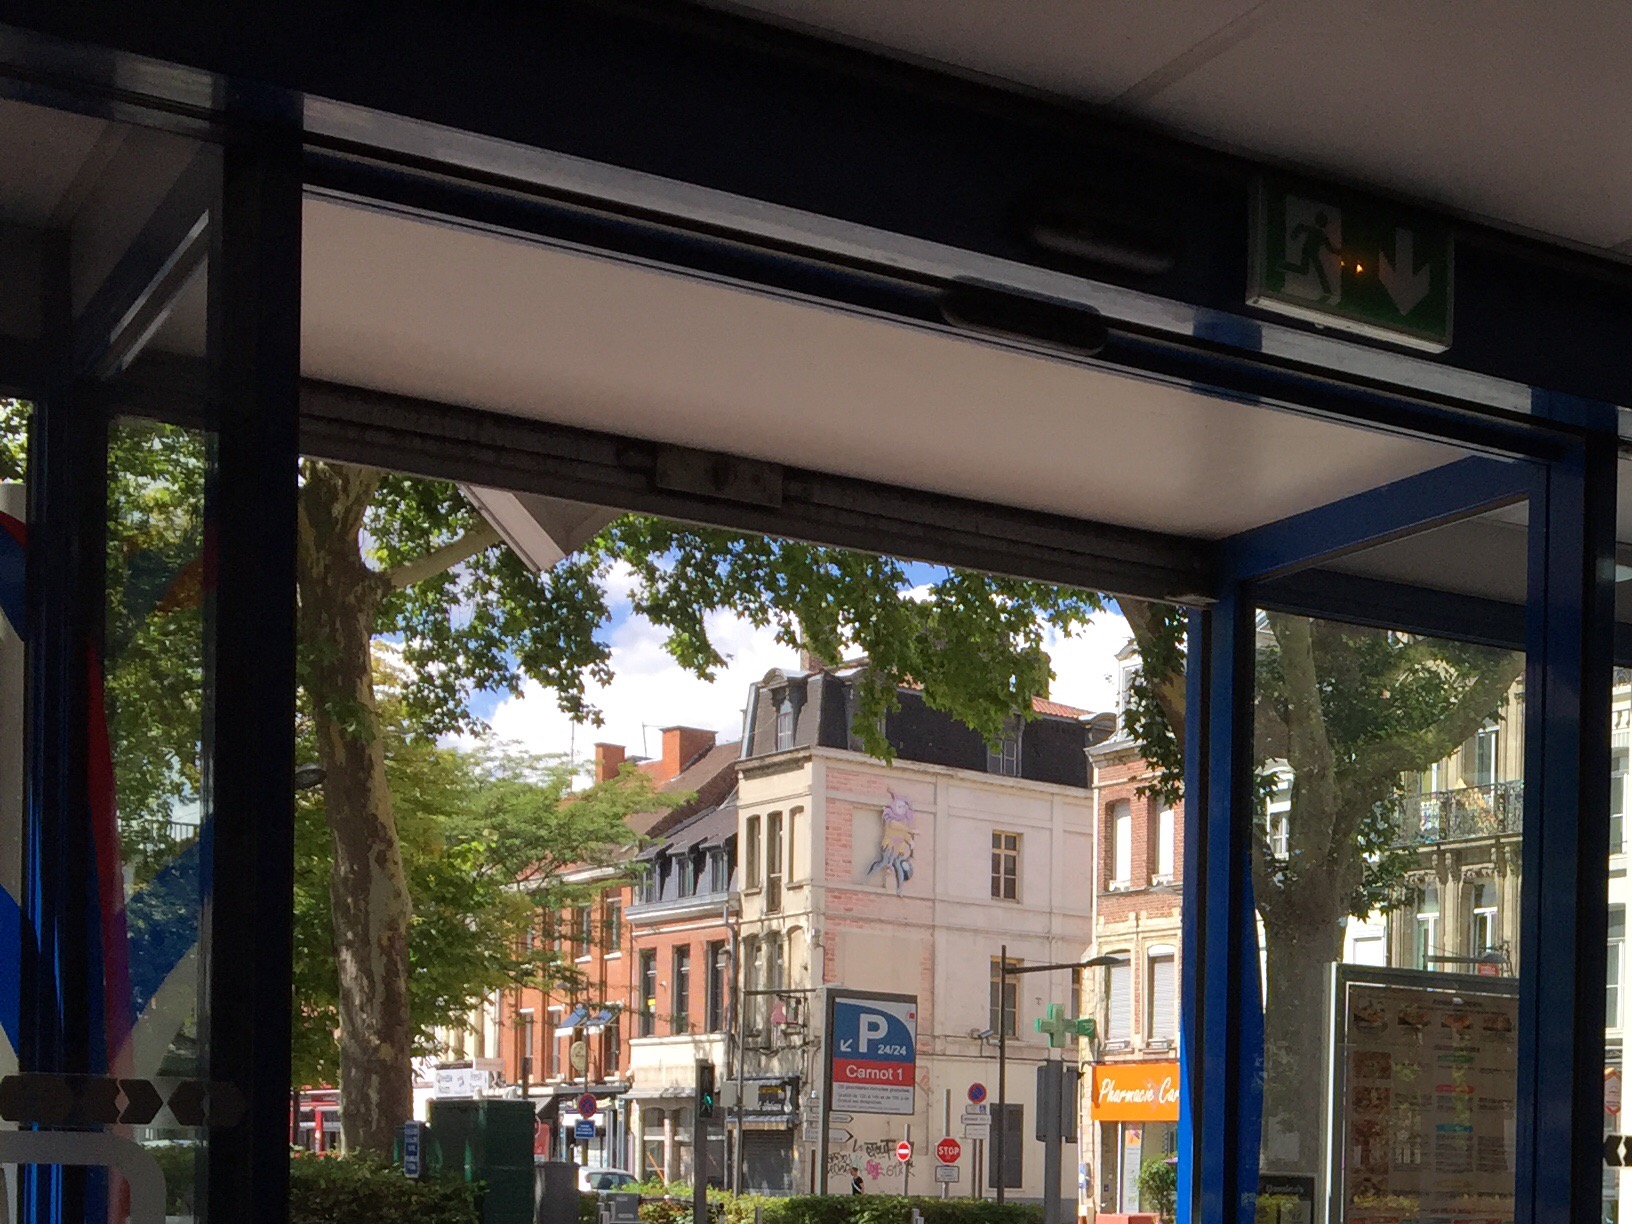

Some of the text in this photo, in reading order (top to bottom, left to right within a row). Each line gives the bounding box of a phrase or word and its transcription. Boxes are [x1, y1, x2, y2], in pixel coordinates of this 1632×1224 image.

[858, 1012, 888, 1053] P
[877, 1044, 907, 1056] 24/24
[845, 1064, 904, 1081] Carnot 1
[1099, 1077, 1155, 1103] Pharmacie
[938, 1146, 960, 1156] STOP
